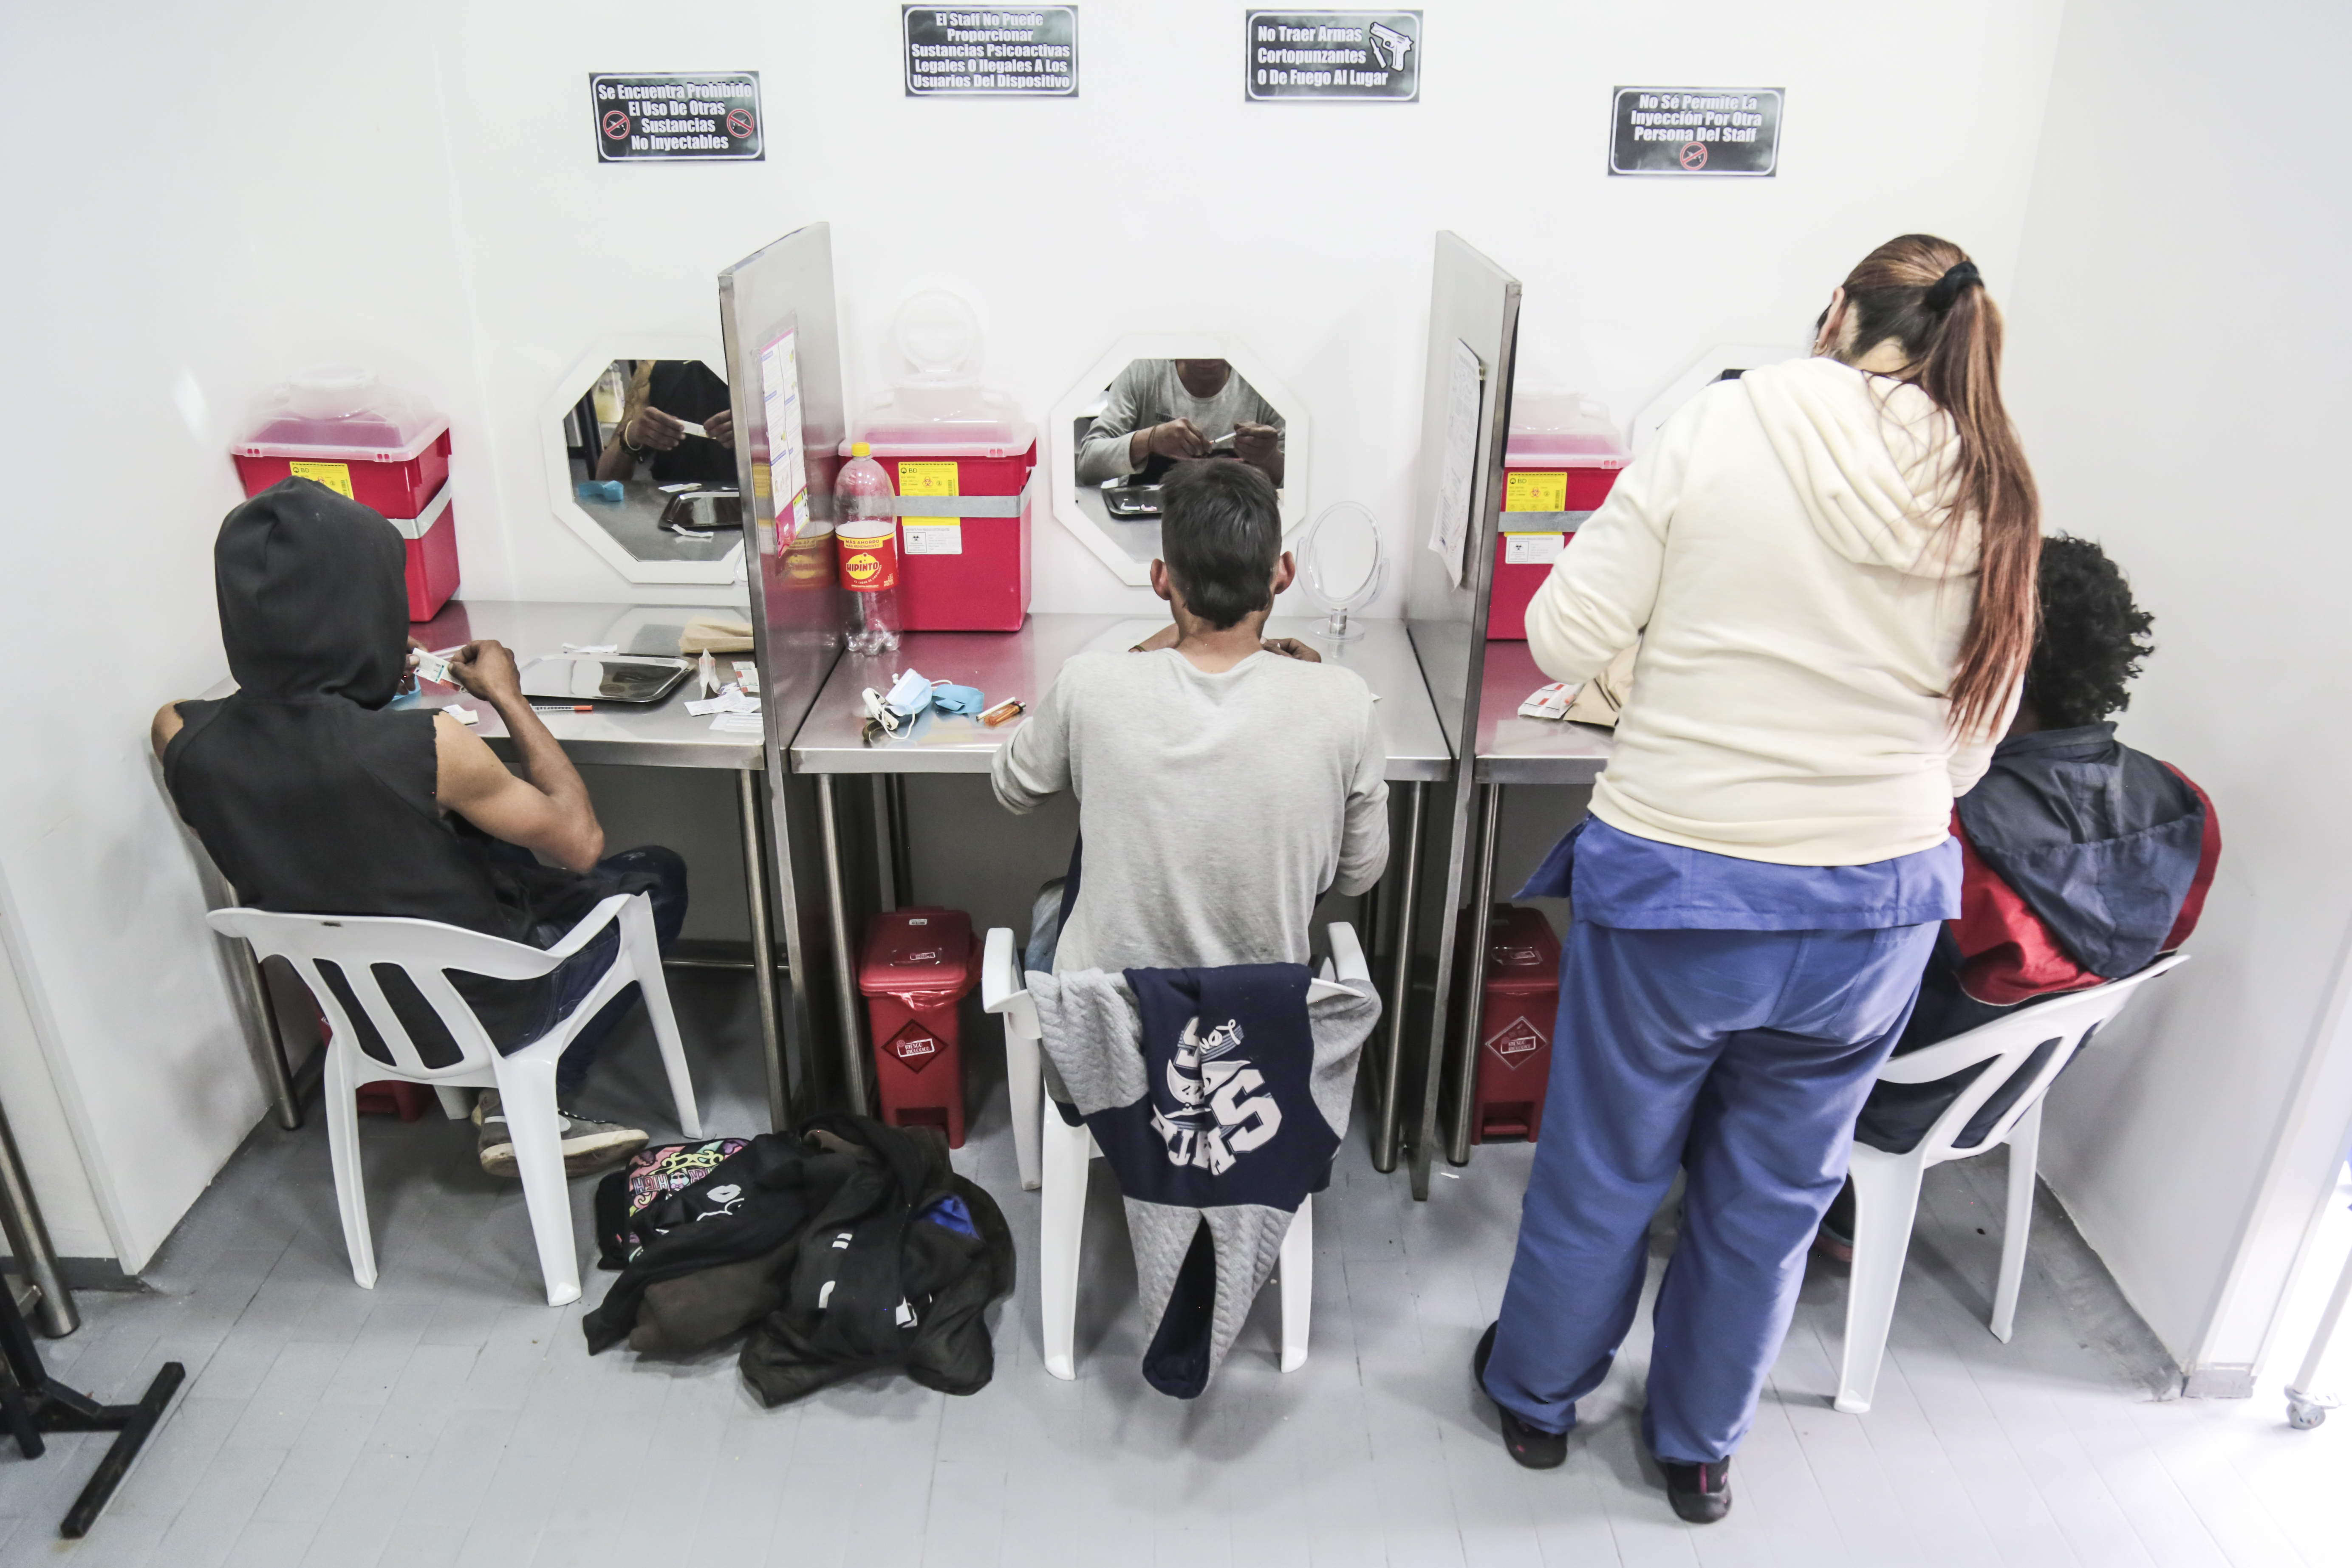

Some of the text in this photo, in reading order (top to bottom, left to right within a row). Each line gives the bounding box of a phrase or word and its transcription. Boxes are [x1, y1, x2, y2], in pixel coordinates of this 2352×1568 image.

[936, 12, 1043, 25] El Staff No Puede
[947, 28, 1033, 42] Proporcionar
[1258, 25, 1362, 42] No Traer Armas
[912, 43, 1070, 57] Sustancias Psicoactivas
[1258, 47, 1366, 65] Cortopunzantes
[915, 59, 1067, 73] Legales O Ilegales A Los
[913, 74, 1070, 88] Usuarios Del Dispositivo
[1258, 69, 1388, 87] O De Fuego Al Lugar
[599, 82, 752, 99] Se Encuentra Prohibido
[629, 100, 726, 116] El Uso De Otras
[1640, 94, 1758, 110] No Sé Permite La
[642, 118, 715, 133] Sustancias
[1631, 110, 1762, 126] Inyección Por Otra
[1634, 126, 1757, 142] Persona Del Staff
[631, 134, 729, 151] No Inyectables
[846, 561, 879, 572] HIPINTO
[635, 1174, 668, 1194] HIGH
